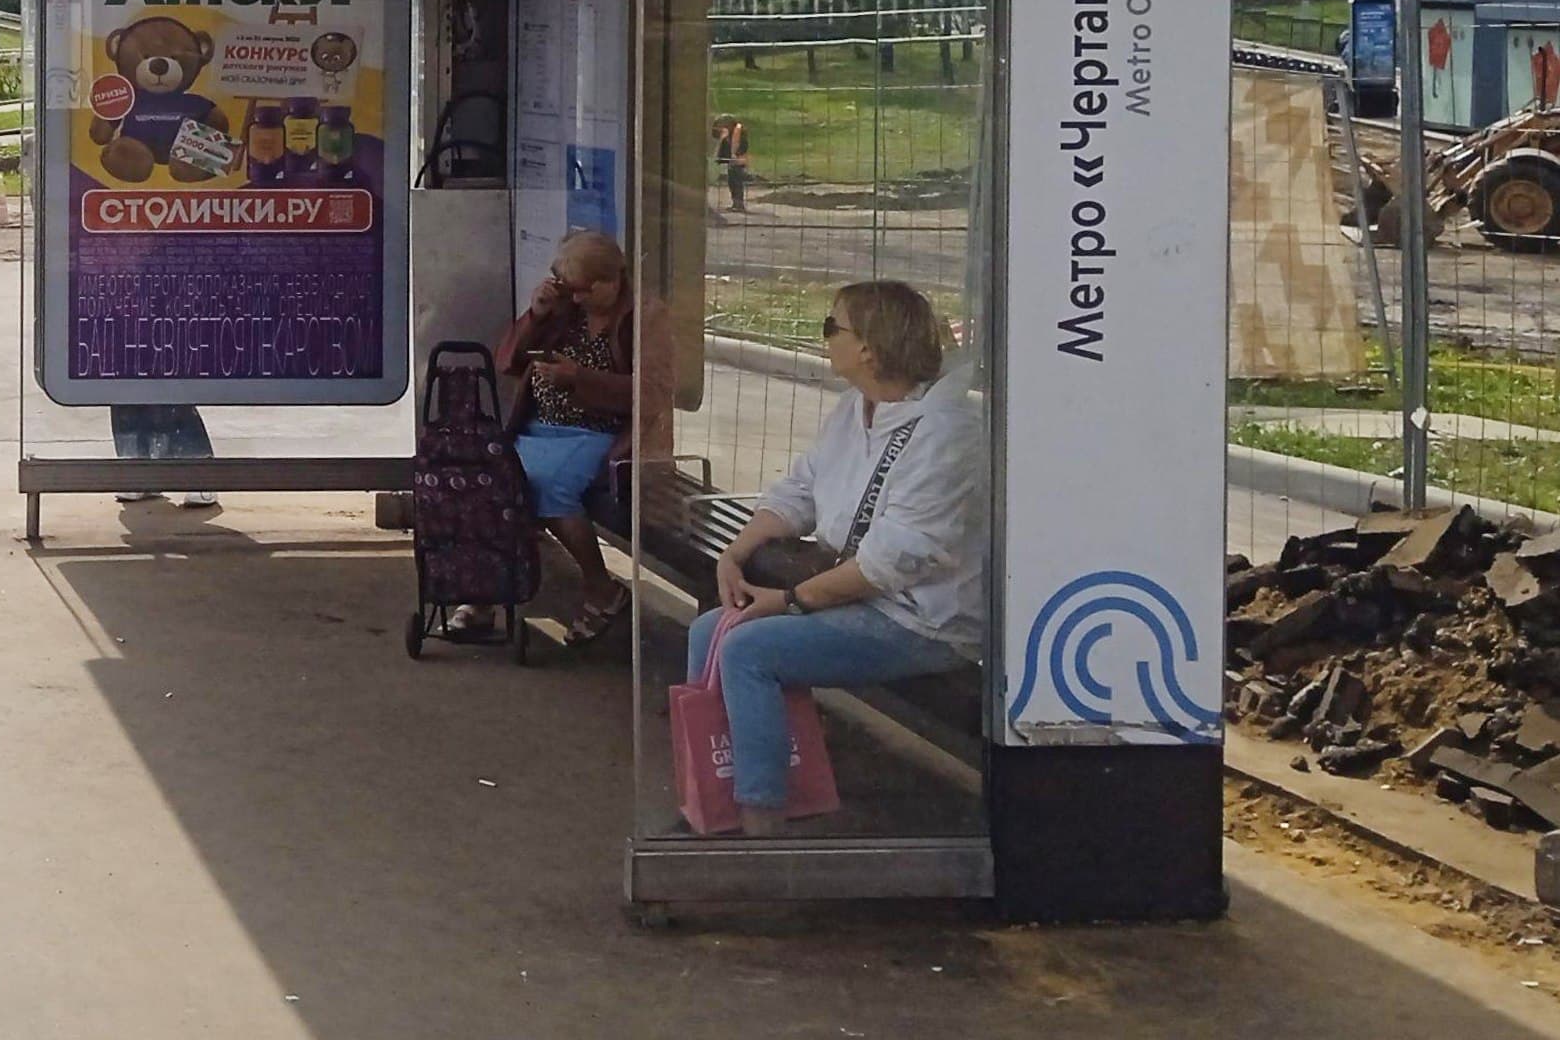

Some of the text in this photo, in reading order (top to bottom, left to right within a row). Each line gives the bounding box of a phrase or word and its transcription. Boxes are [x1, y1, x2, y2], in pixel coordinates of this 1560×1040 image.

[224, 45, 309, 62] КОНКУРС
[1125, 22, 1152, 117] Metro
[99, 196, 323, 229] СТОЛИЧКИ.РУ
[79, 274, 140, 296] ИМЕЮТСЯ
[1056, 200, 1117, 362] Метро
[125, 317, 148, 376] НЕ
[151, 317, 245, 376] ЯВЛЯЕТСЯ
